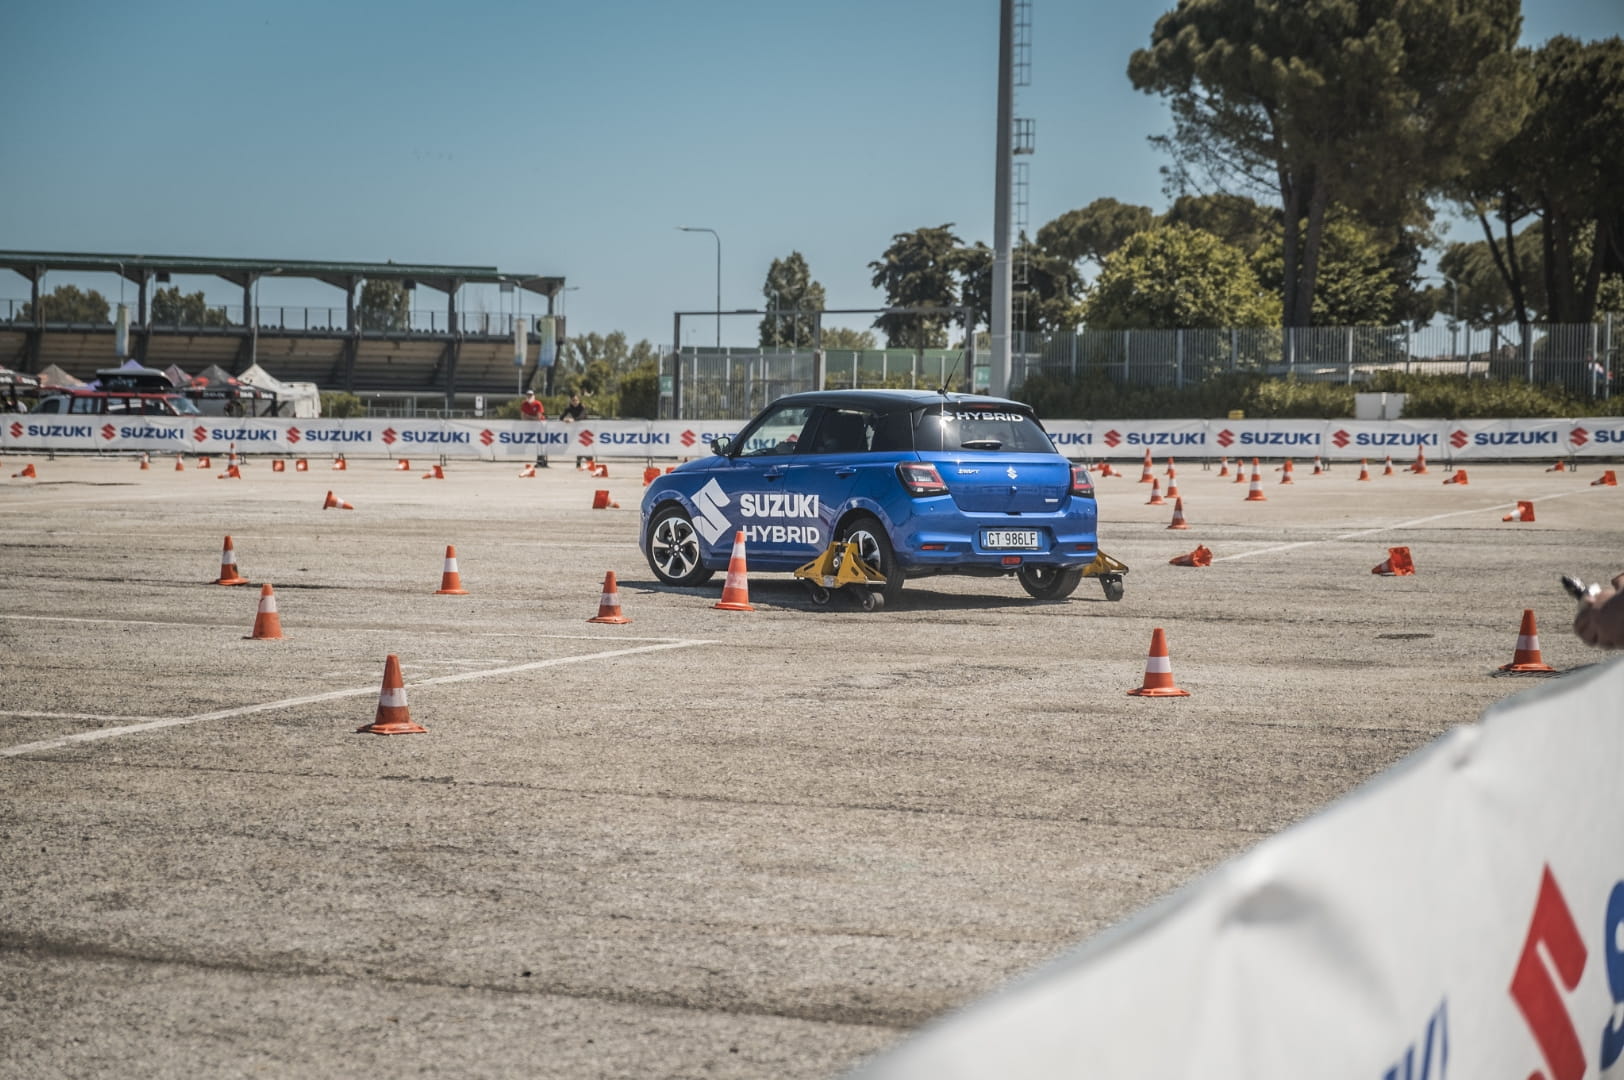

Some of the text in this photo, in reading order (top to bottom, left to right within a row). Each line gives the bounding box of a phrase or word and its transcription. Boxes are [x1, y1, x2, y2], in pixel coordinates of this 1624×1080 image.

[956, 412, 1024, 422] HYBRID
[28, 425, 92, 438] SUZUKI
[121, 426, 184, 439] SUZUKI
[212, 428, 277, 441] SUZUKI
[305, 430, 372, 442] SUZUKI
[401, 431, 470, 443] SUZUKI
[500, 432, 568, 444] SUZUKI
[1474, 431, 1558, 445] SUZUKI
[599, 432, 670, 445] SUZUKI
[1047, 433, 1093, 445] ZUKI
[1126, 432, 1206, 445] SUZUKI
[1239, 432, 1321, 445] SUZUKI
[1356, 433, 1438, 446] SUZUKI
[740, 494, 820, 518] SUZUKI
[742, 525, 820, 544] HYBRID
[988, 532, 1036, 546] GT 986LF
